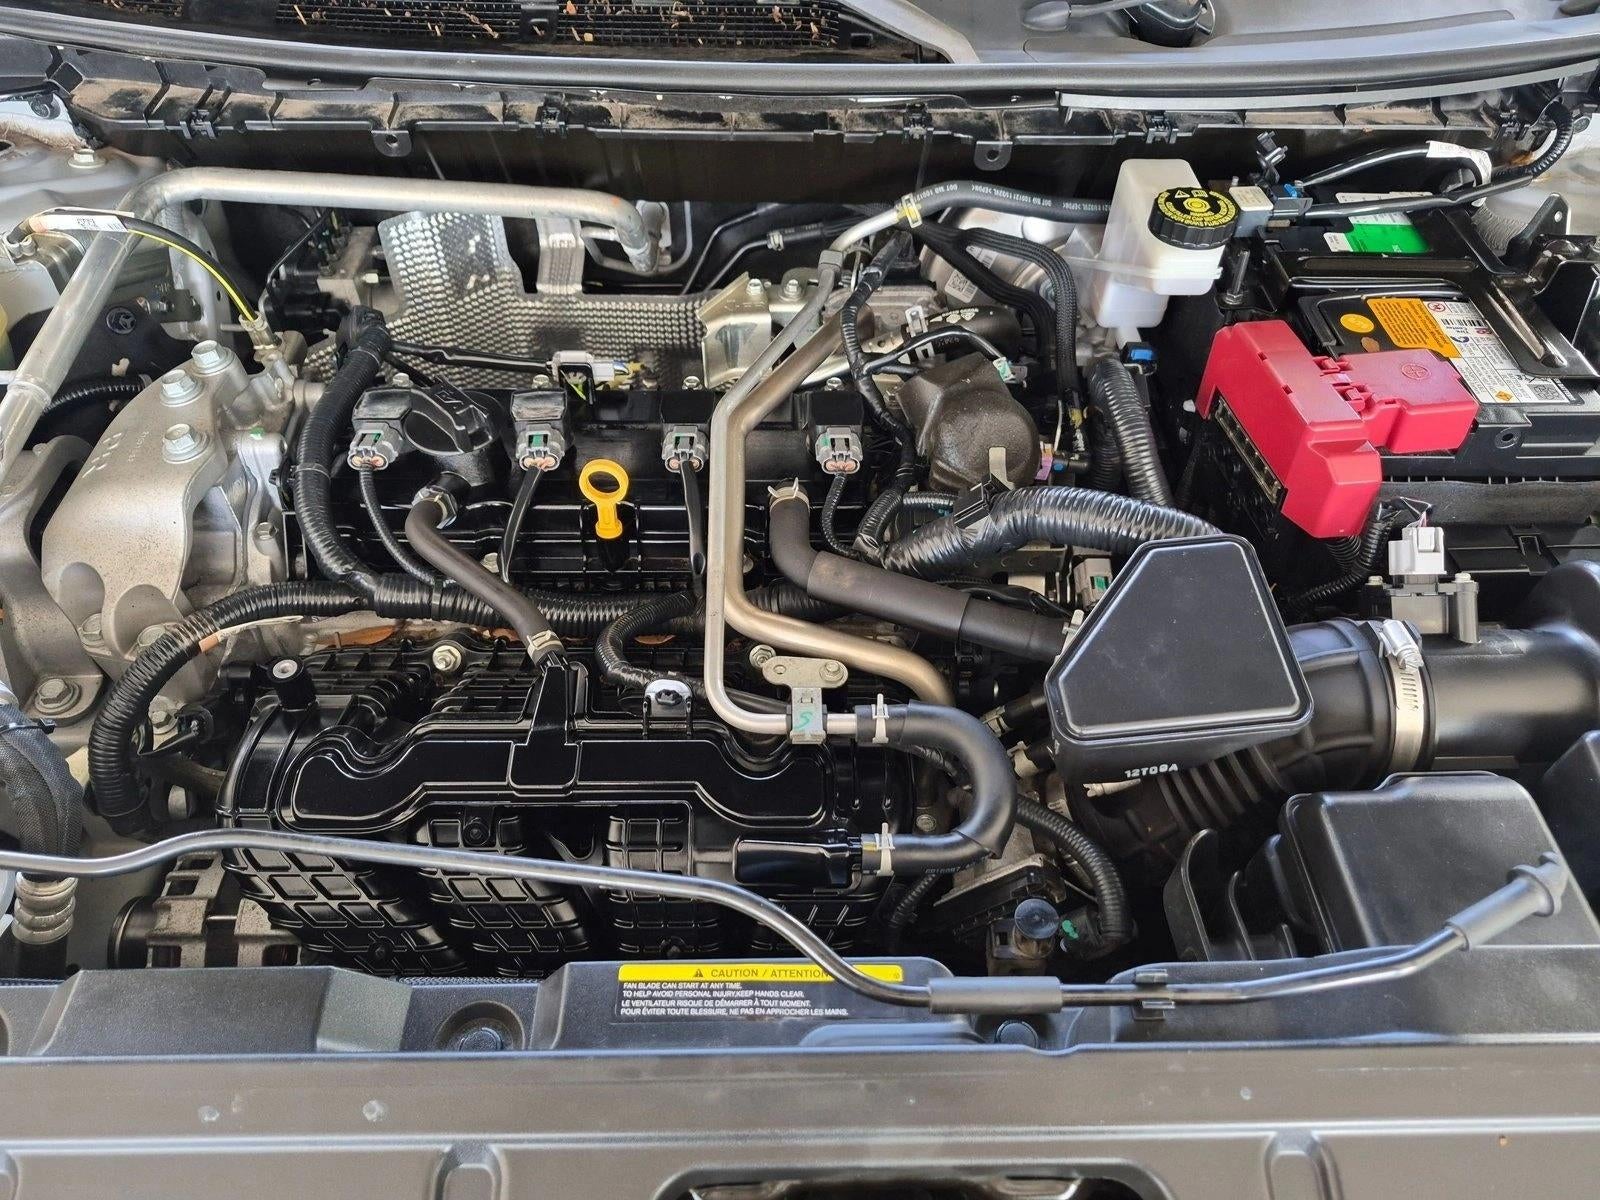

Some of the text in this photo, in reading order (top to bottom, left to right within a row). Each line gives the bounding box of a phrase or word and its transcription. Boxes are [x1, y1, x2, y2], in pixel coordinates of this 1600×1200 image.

[711, 968, 759, 978] CAUTION
[622, 990, 632, 998] TO
[633, 990, 651, 998] HELP
[652, 990, 674, 998] AVOID
[675, 990, 711, 998] PERSONAL
[755, 990, 779, 998] HANDS
[715, 998, 753, 1007] DÉMARRER
[641, 1006, 666, 1015] ÉVITER
